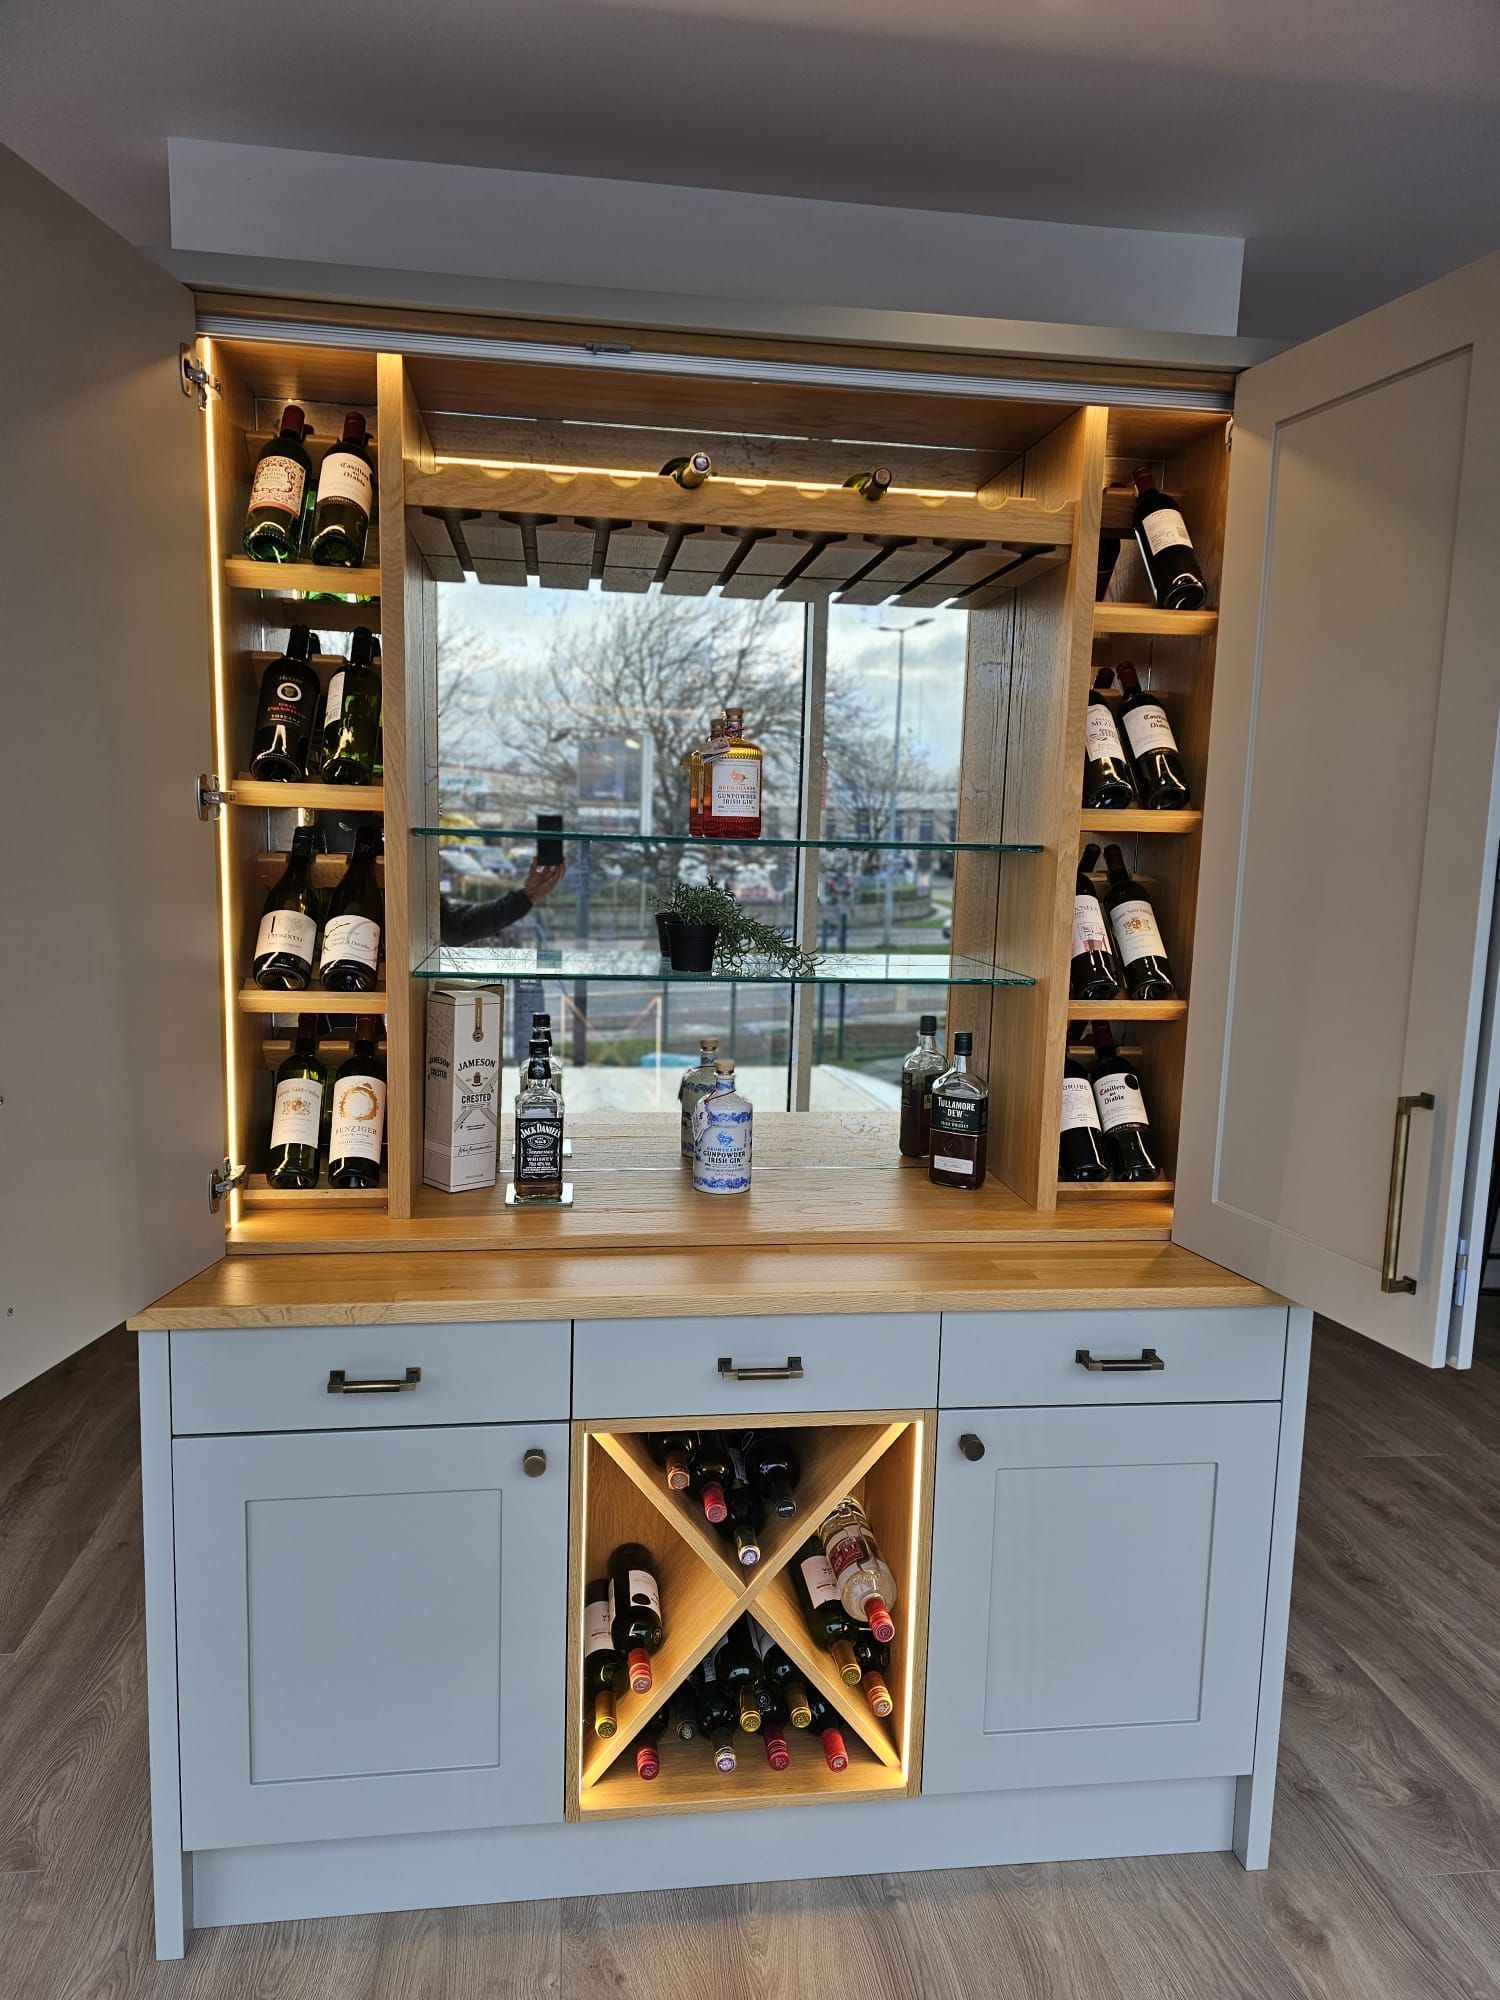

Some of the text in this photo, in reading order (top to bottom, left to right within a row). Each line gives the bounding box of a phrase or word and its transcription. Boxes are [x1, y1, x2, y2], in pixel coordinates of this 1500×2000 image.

[428, 1056, 450, 1068] JAMESON
[458, 1058, 496, 1072] JAMESON
[1099, 1085, 1126, 1096] Casillero
[461, 1092, 492, 1104] CRESTED
[1104, 1095, 1124, 1104] Diablo
[937, 1097, 976, 1112] TULLAMORE
[947, 1109, 963, 1118] DEW
[520, 1123, 561, 1138] JACK DANIEL'S
[703, 1150, 746, 1158] GUNPOWDER
